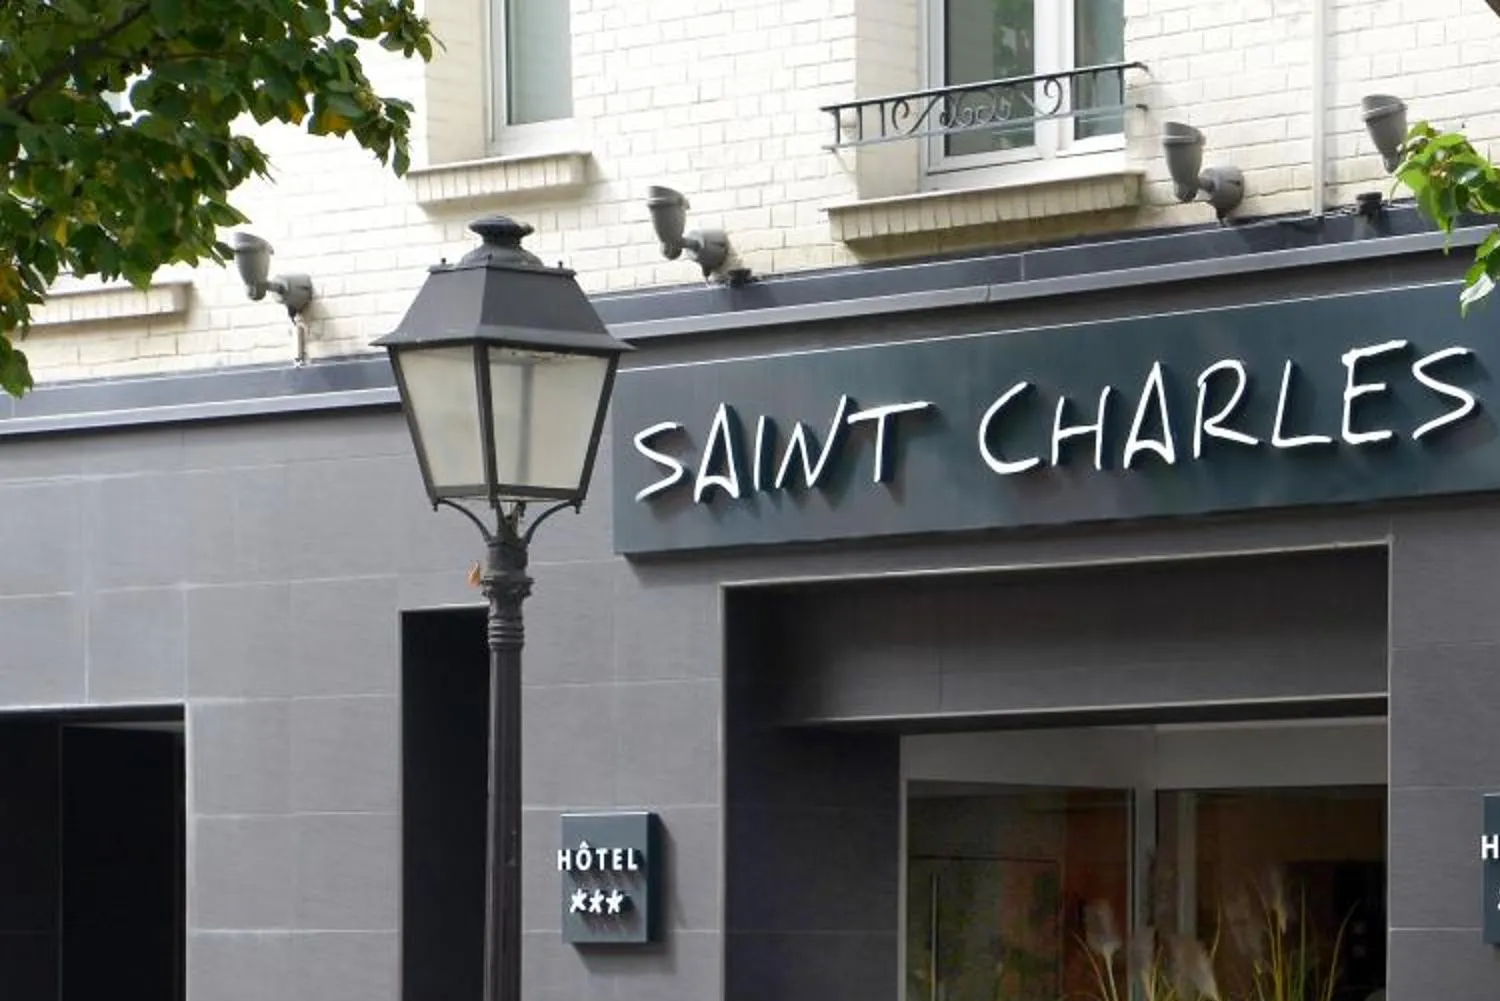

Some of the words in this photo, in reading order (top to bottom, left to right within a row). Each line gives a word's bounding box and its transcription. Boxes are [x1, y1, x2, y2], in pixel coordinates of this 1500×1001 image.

[633, 394, 933, 504] SAINT
[978, 339, 1476, 475] CHARLES
[557, 840, 639, 871] HÔTEL
